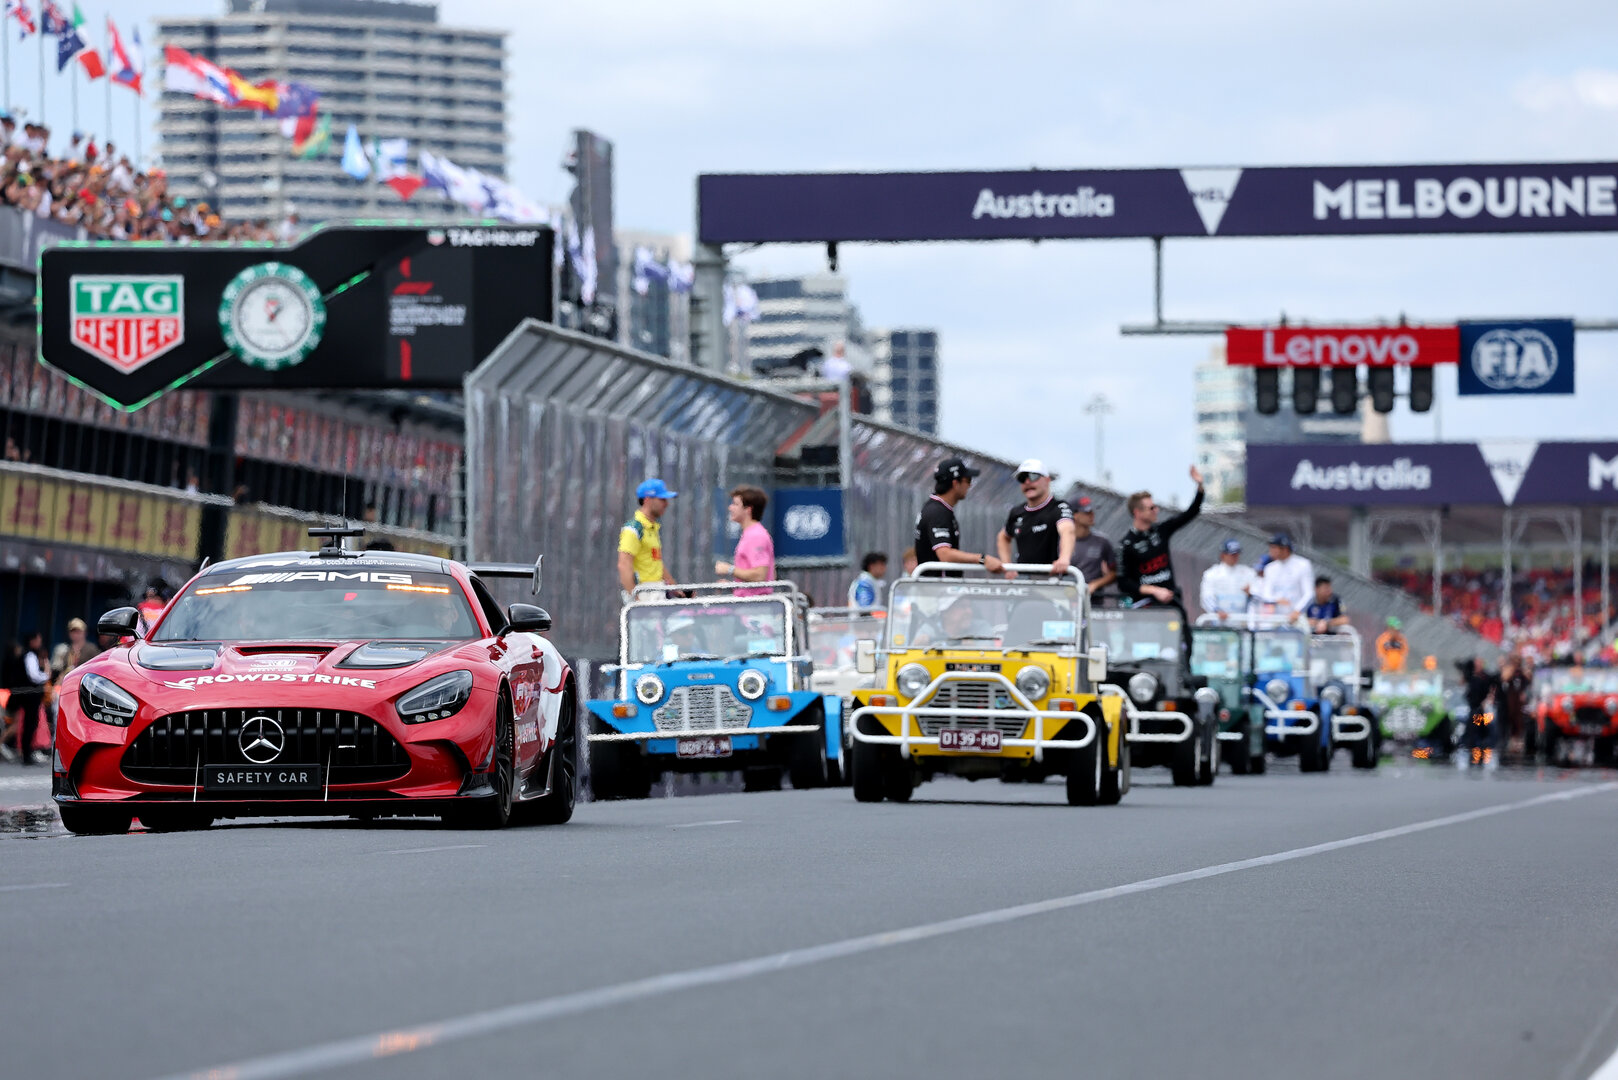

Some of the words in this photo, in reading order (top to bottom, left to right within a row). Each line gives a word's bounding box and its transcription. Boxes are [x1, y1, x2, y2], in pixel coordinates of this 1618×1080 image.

[973, 186, 1115, 218] Australia
[1313, 176, 1618, 219] MELBOURNE
[80, 284, 173, 311] TAG
[78, 319, 176, 363] HEUER
[1263, 331, 1419, 364] Lenovo
[1480, 341, 1550, 378] FIA
[1291, 458, 1431, 490] Australia
[288, 571, 413, 585] AMG
[179, 673, 377, 689] CROWDSTRIKE
[217, 772, 272, 783] SAFETY
[279, 772, 308, 783] CAR
